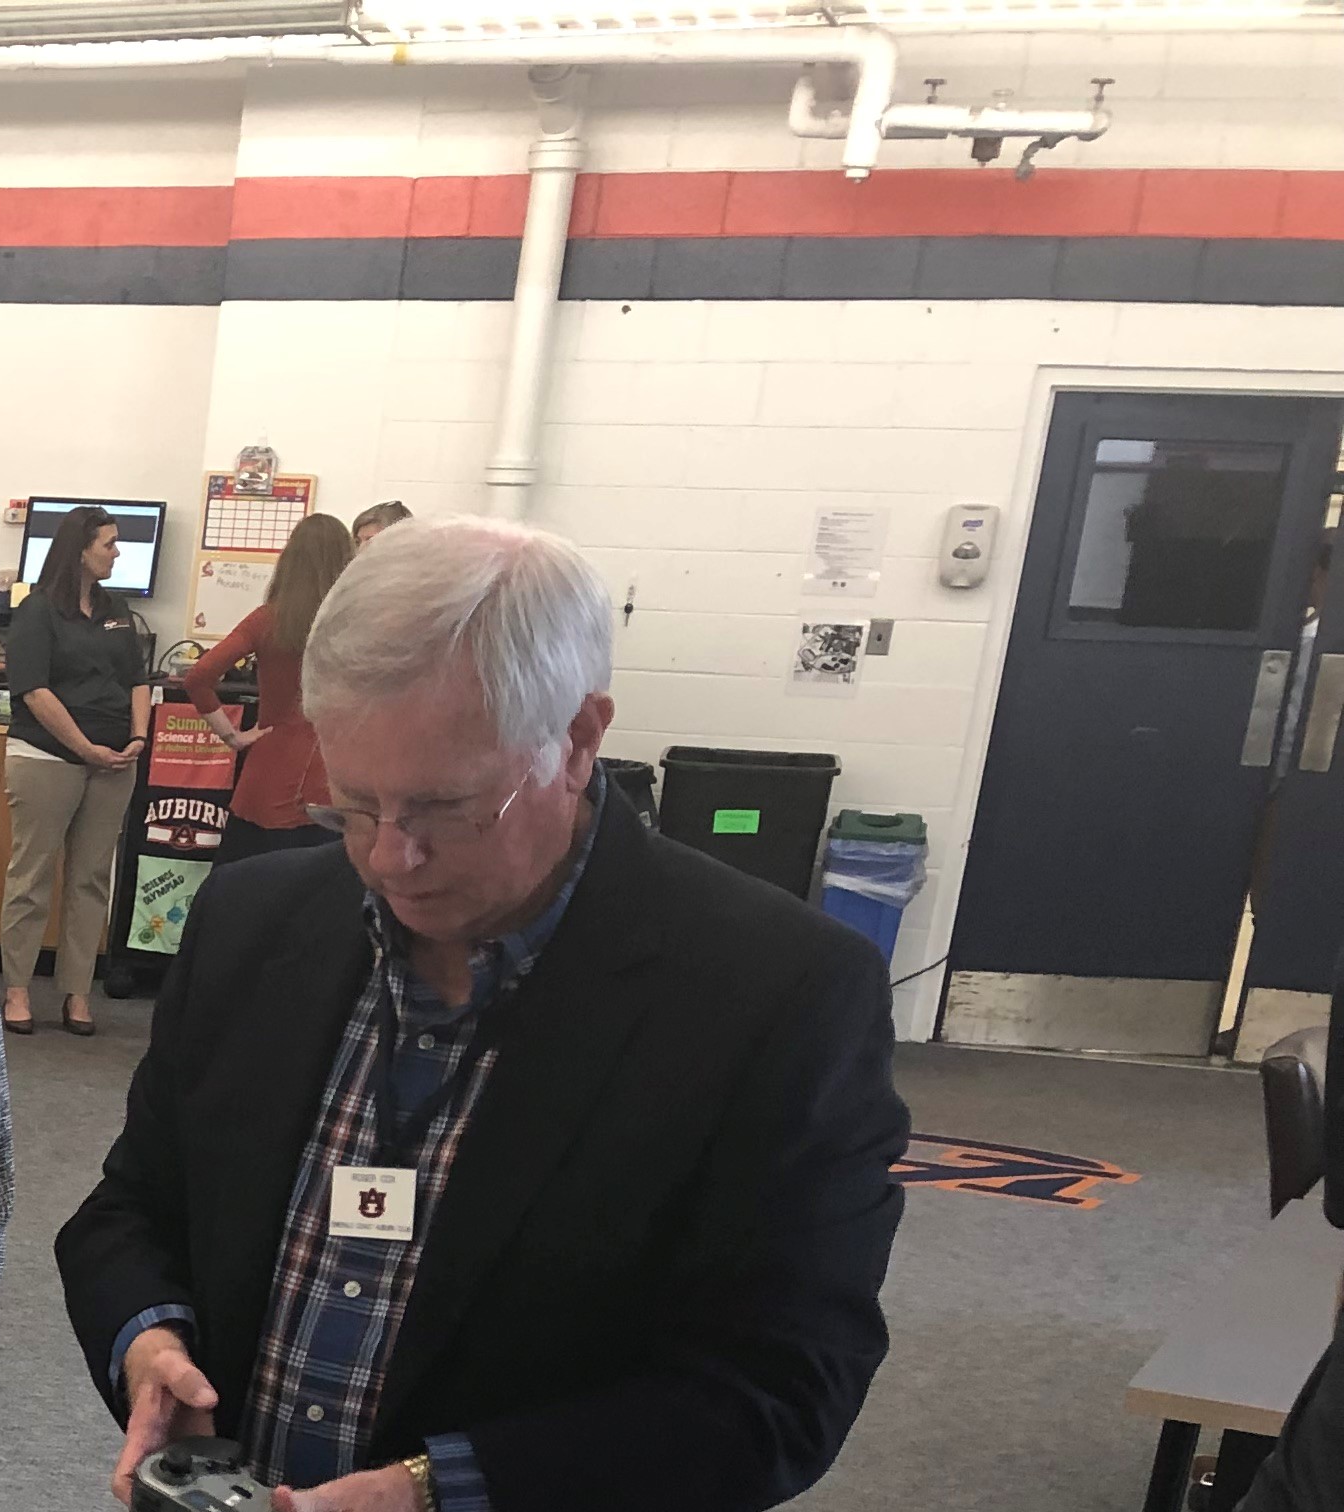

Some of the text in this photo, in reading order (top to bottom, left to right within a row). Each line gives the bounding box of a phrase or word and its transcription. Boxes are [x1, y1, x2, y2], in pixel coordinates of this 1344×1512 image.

[165, 715, 212, 732] Summ
[156, 731, 194, 744] Science
[196, 732, 208, 744] &
[144, 798, 230, 830] AUBURN
[140, 868, 175, 895] SCIENCE
[141, 873, 186, 907] OLYMPIAD
